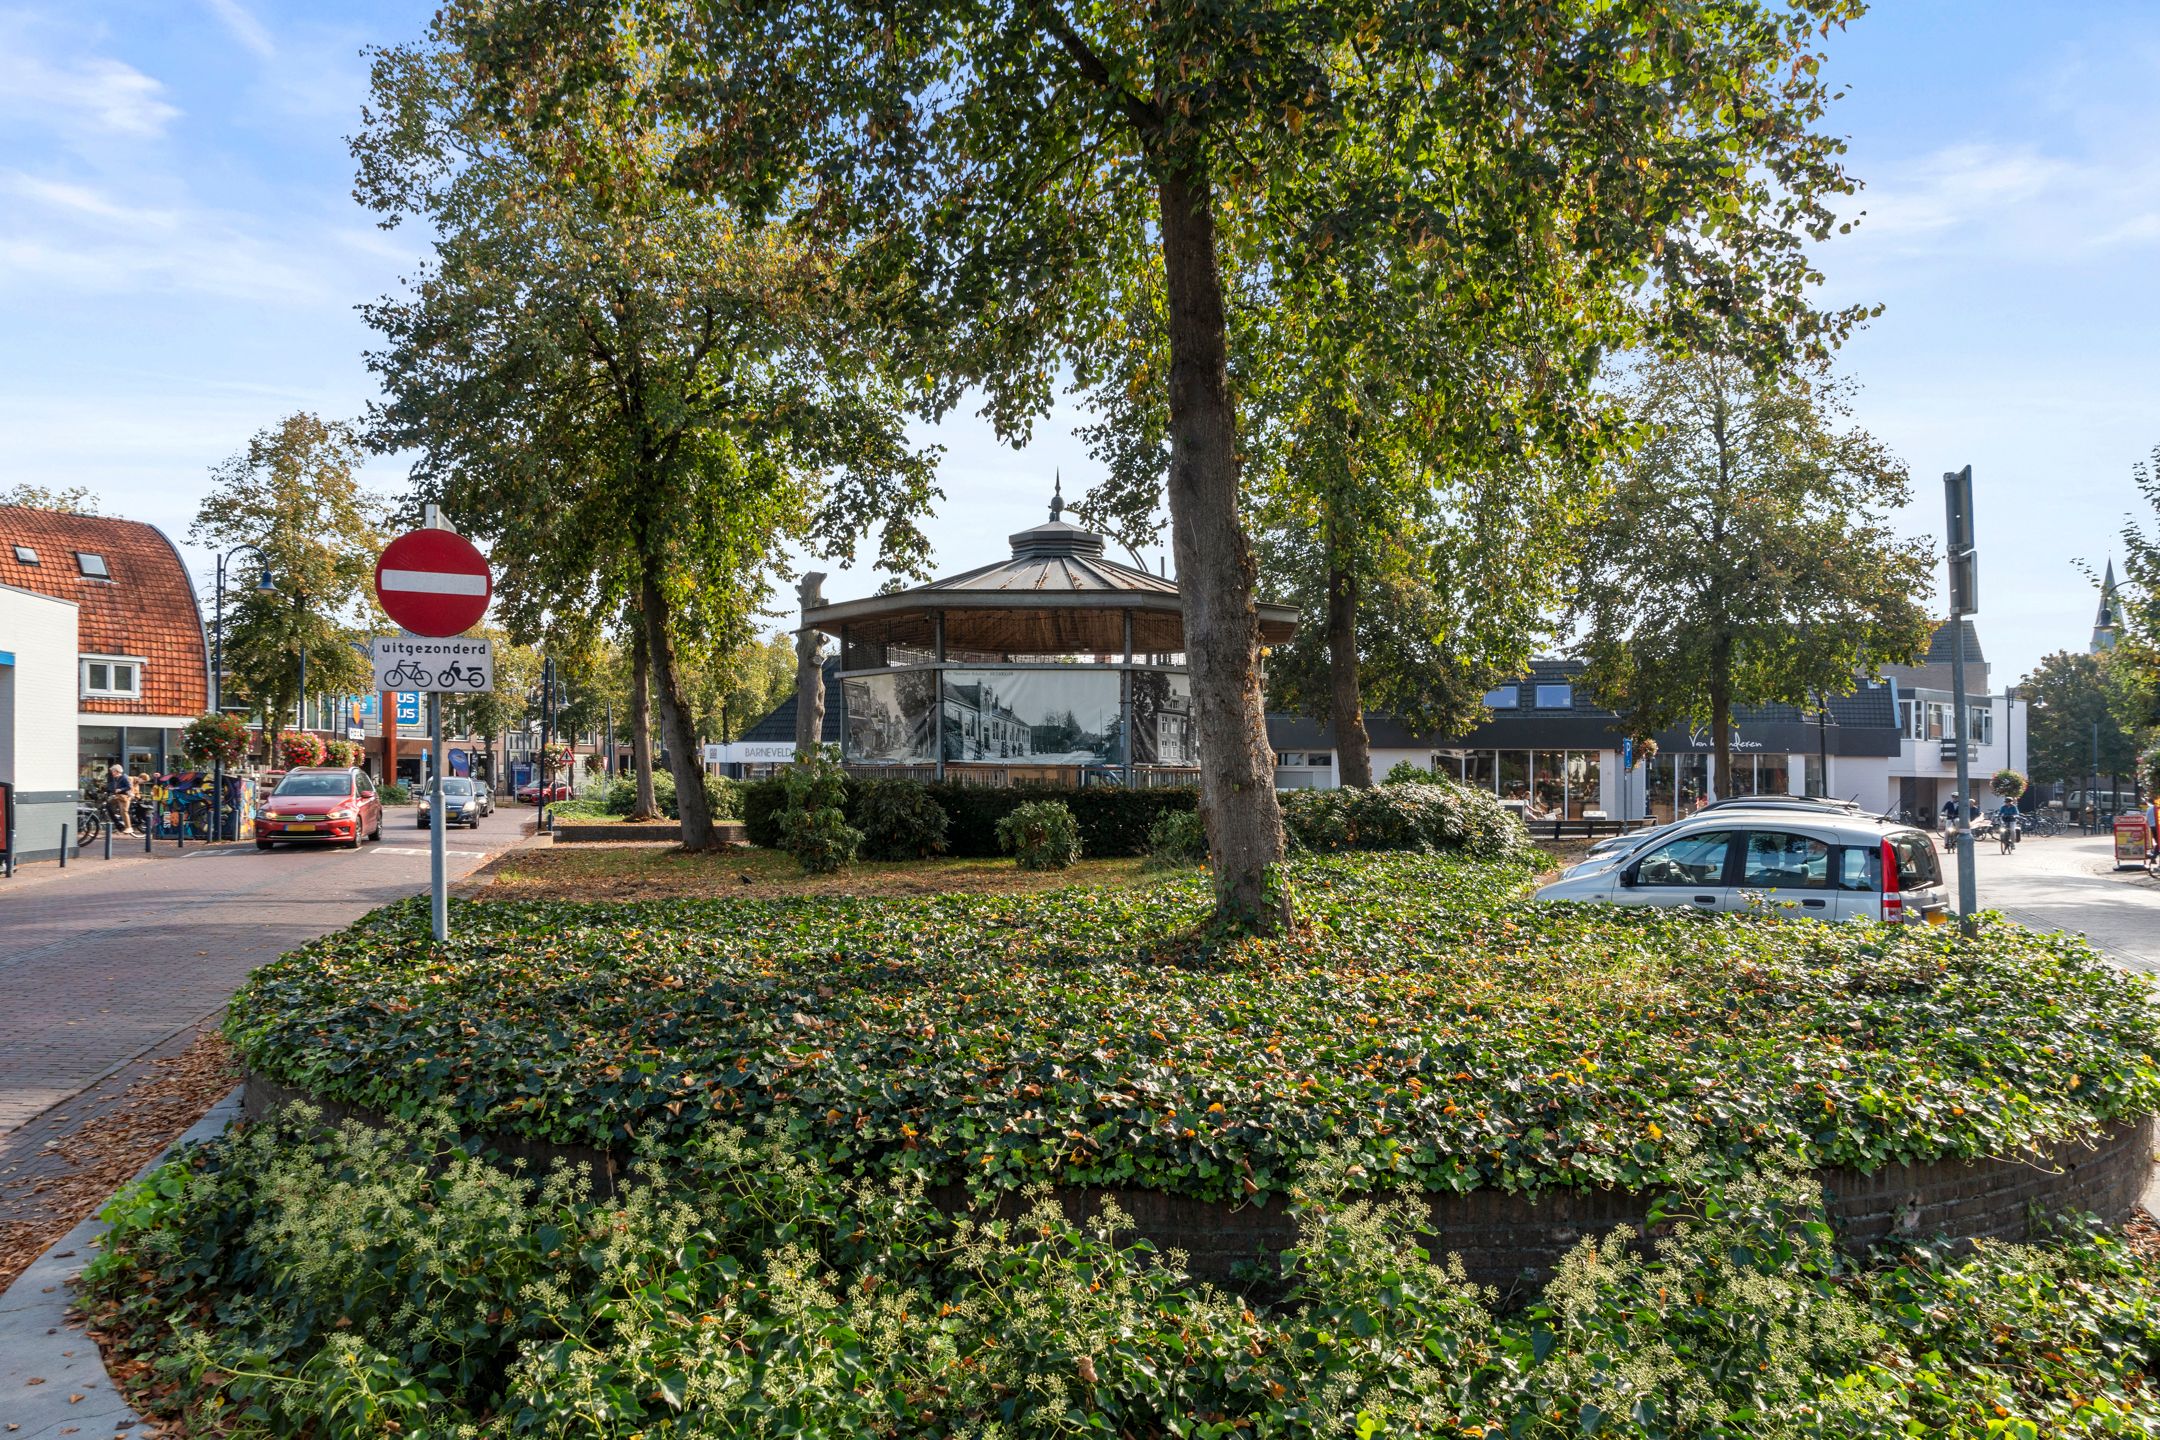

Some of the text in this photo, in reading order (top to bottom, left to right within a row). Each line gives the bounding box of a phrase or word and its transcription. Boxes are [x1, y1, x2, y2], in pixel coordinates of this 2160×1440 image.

[381, 642, 486, 656] uitgezonderd
[1689, 726, 1707, 747] Van
[744, 747, 792, 758] BARNEVELD
